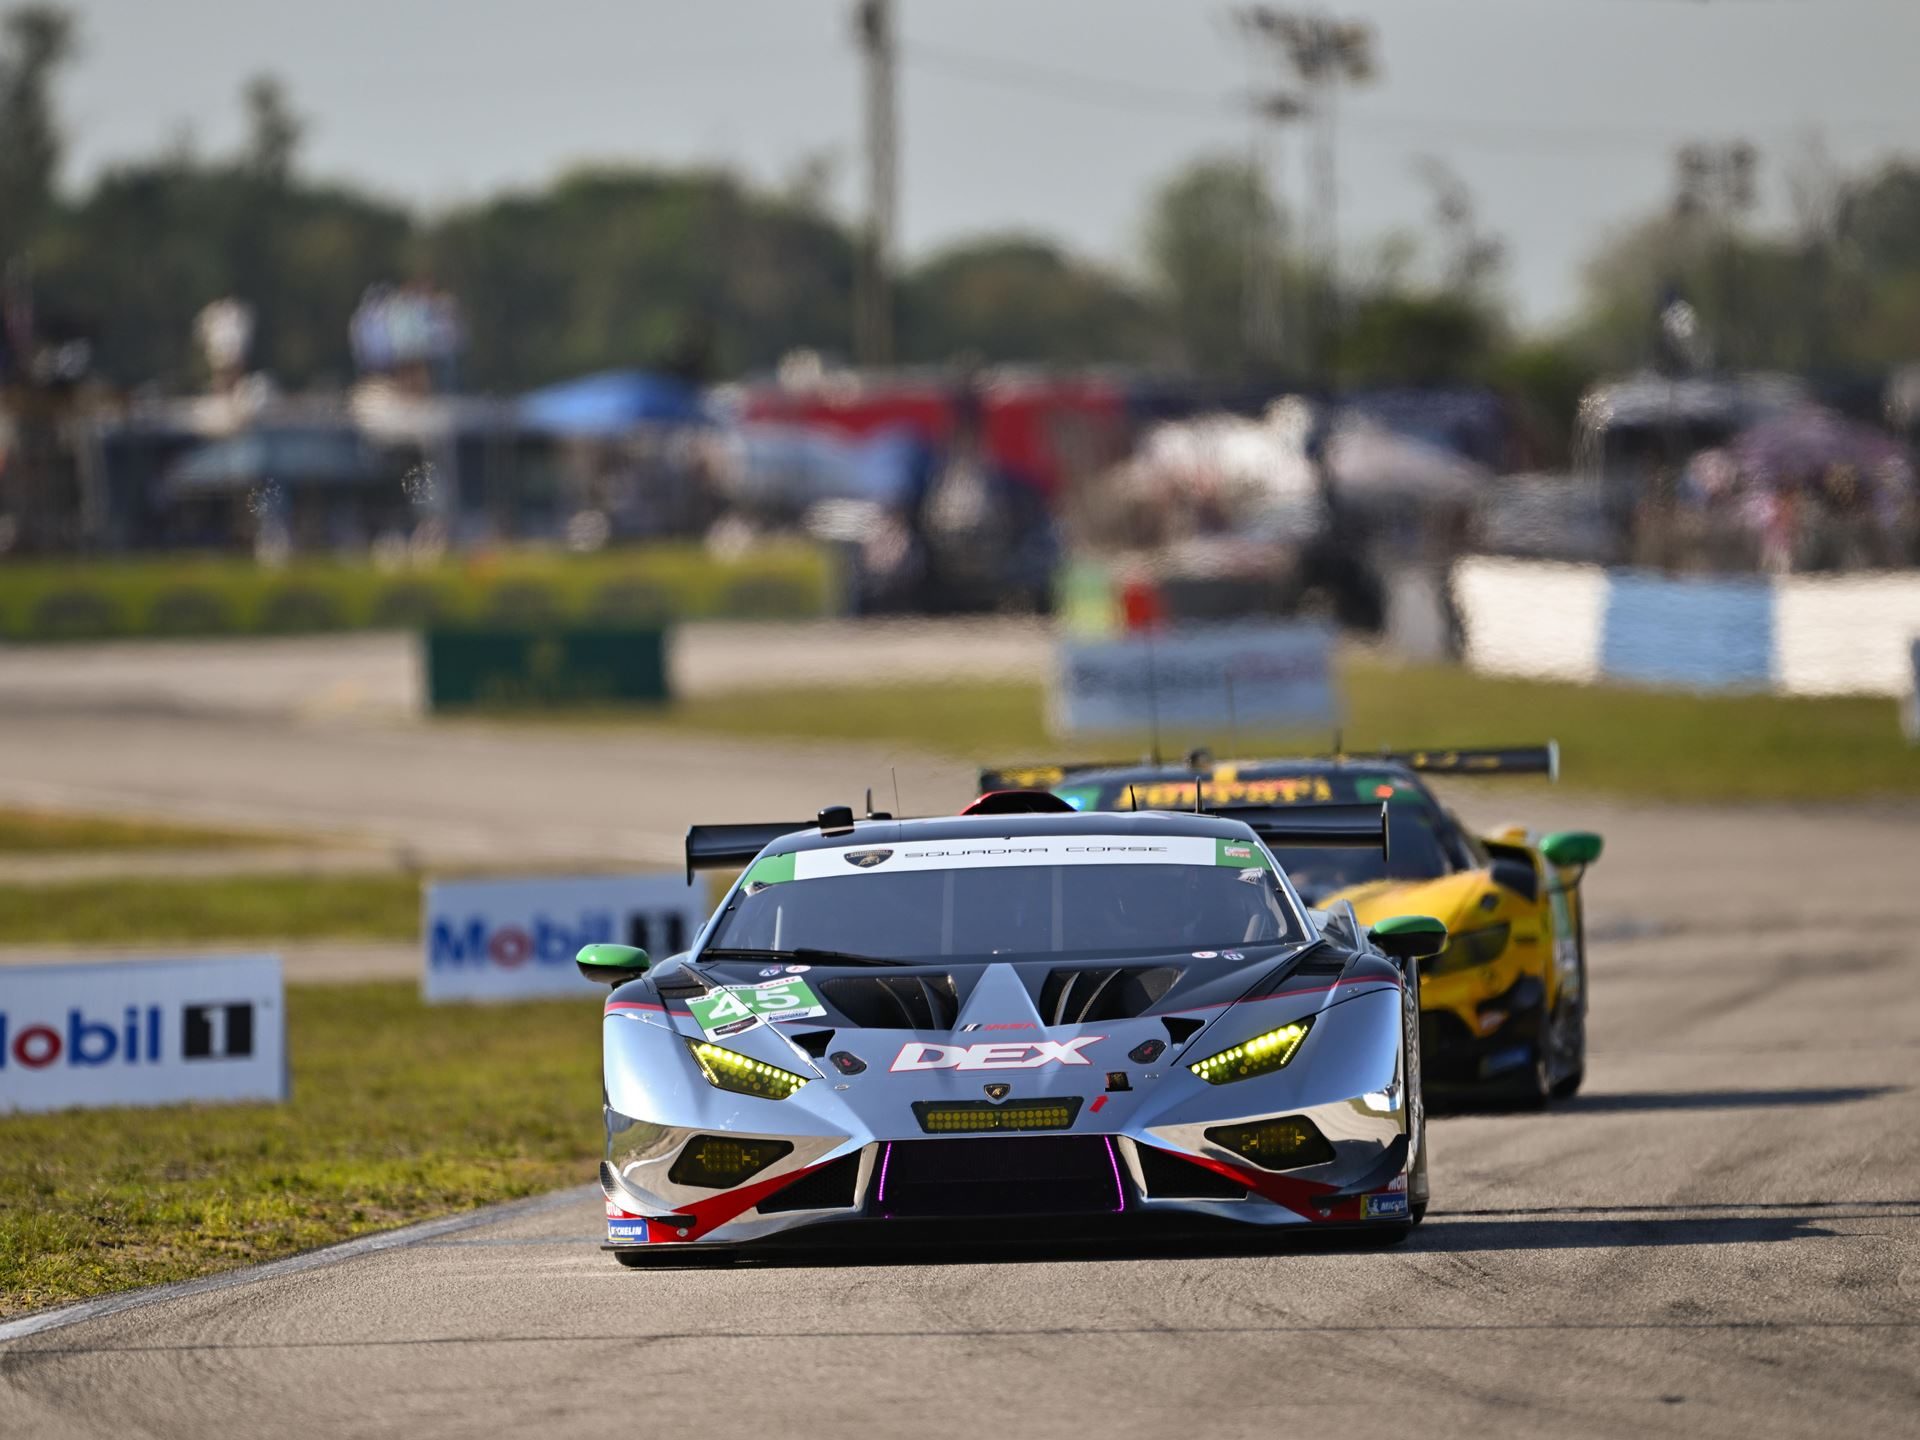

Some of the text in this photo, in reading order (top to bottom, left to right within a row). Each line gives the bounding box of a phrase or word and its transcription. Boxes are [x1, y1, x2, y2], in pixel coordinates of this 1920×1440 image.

[904, 845, 1169, 859] SQUADRA CORSE
[430, 911, 613, 973] Mobil
[708, 986, 800, 1020] 45
[0, 1005, 162, 1070] obil
[889, 1036, 1107, 1073] DEX
